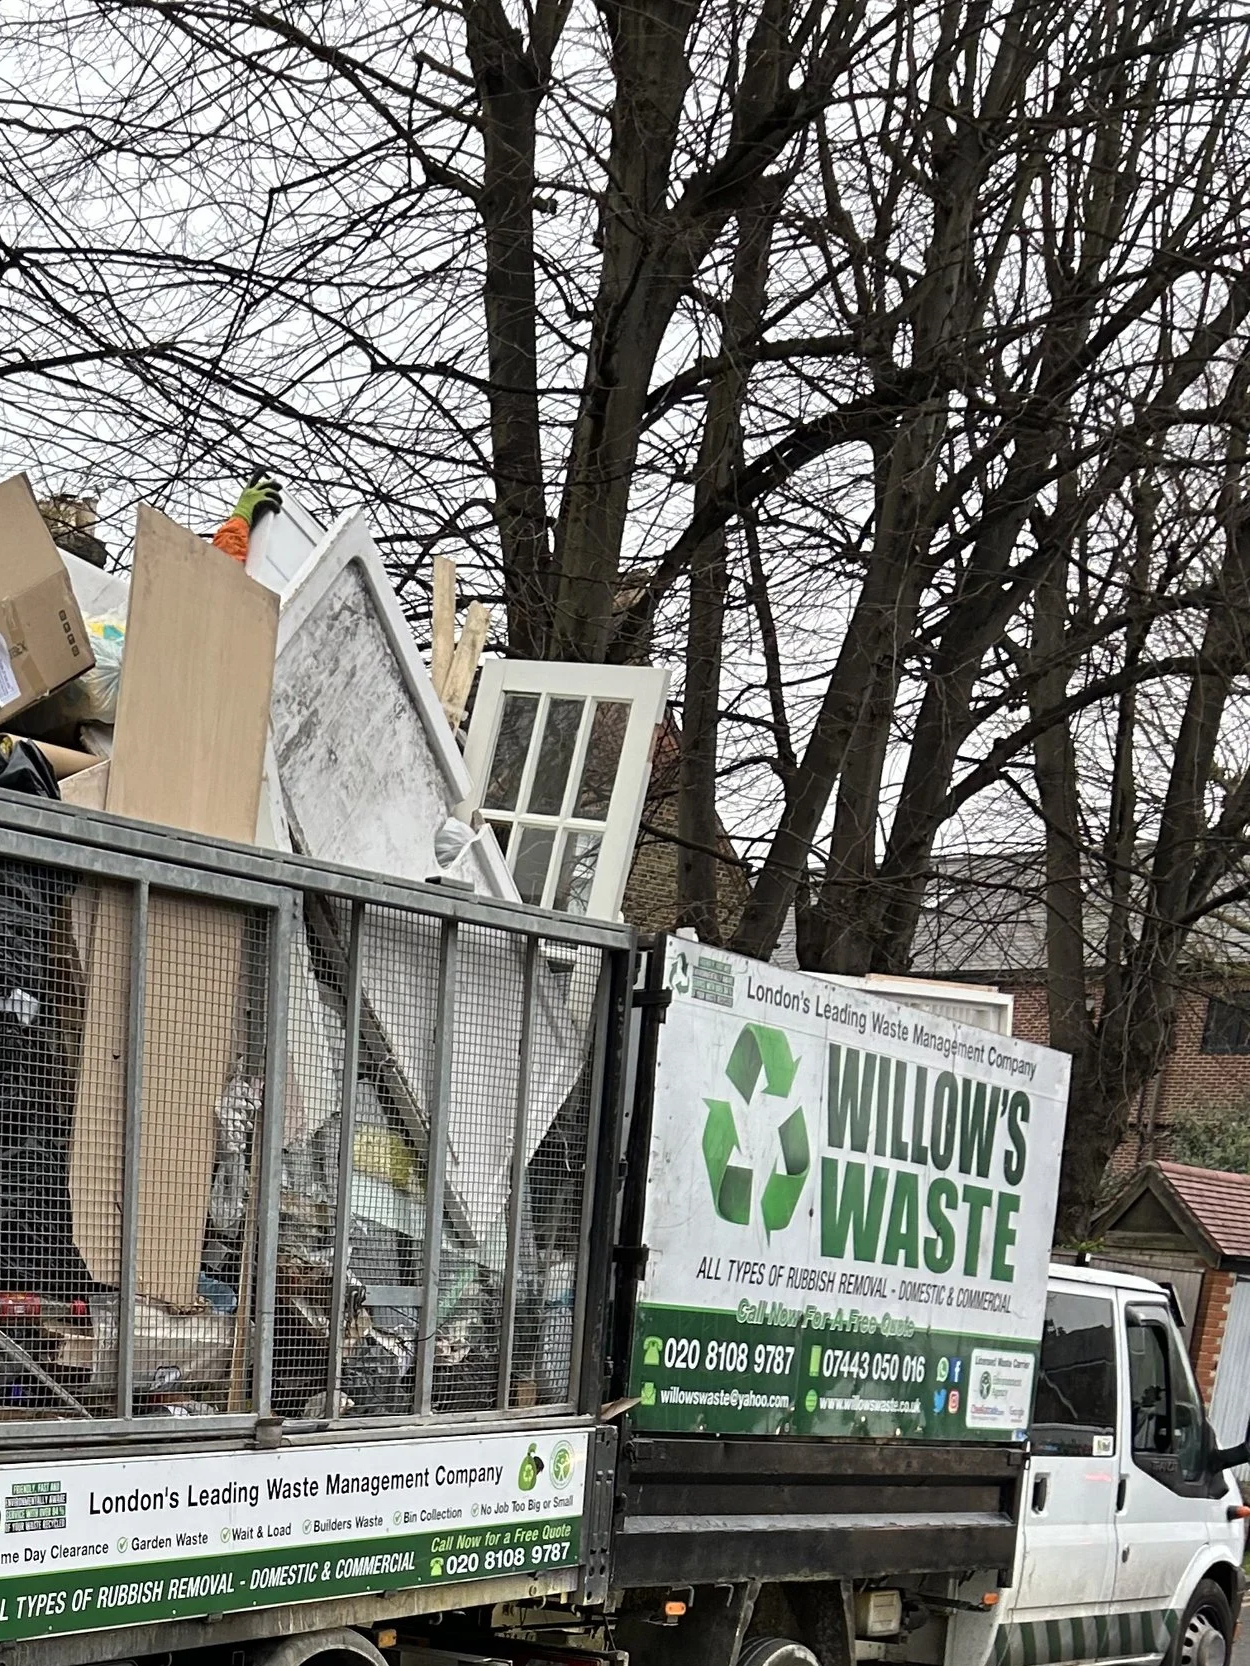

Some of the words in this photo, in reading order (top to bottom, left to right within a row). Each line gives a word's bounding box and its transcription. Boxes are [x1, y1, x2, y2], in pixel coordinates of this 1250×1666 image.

[747, 976, 810, 1014] London's
[815, 995, 867, 1034] Leading
[872, 1011, 908, 1041] Waste
[913, 1024, 984, 1063] Management
[988, 1046, 1037, 1082] Company
[828, 1043, 1030, 1186] WILLOW'S
[821, 1157, 1020, 1282] WASTE
[696, 1256, 721, 1280] ALL
[728, 1260, 764, 1286] TYPES
[769, 1264, 785, 1287] OF
[786, 1267, 835, 1293] RUBBISH
[838, 1273, 887, 1299] REMOVAL
[899, 1280, 945, 1306] DOMESTIC
[947, 1287, 954, 1307] &
[956, 1289, 1012, 1313] COMMERCIAL
[736, 1298, 764, 1323] Call
[767, 1302, 800, 1327] Now
[801, 1305, 827, 1330] For
[830, 1309, 845, 1331] A
[847, 1309, 878, 1334] Free
[880, 1311, 915, 1339] Quote
[664, 1338, 700, 1369] 020
[705, 1341, 748, 1372] 8108
[753, 1344, 795, 1375] 9787
[822, 1349, 870, 1379] 07443
[872, 1353, 900, 1381] 050
[902, 1355, 926, 1382] 016
[660, 1386, 789, 1410] willowswaste@yahoo.com
[819, 1395, 921, 1413] www.willowswaste.co.uk
[90, 1486, 179, 1515] London's
[187, 1481, 259, 1508] Leading
[267, 1477, 319, 1500] Waste
[326, 1468, 429, 1496] Management
[435, 1465, 503, 1488] Company
[481, 1503, 492, 1515] No
[494, 1502, 509, 1513] Job
[512, 1501, 525, 1512] Too
[528, 1499, 541, 1512] Big
[543, 1500, 551, 1509] or
[553, 1495, 573, 1508] Small
[314, 1518, 351, 1532] Builders
[355, 1515, 383, 1529] Waste
[403, 1511, 417, 1523] Bin
[420, 1507, 462, 1522] Collection
[131, 1536, 171, 1551] Garden
[176, 1533, 208, 1546] Waste
[232, 1528, 254, 1541] Wait
[257, 1526, 264, 1538] &
[267, 1523, 291, 1537] Load
[431, 1536, 453, 1553] Call
[456, 1534, 481, 1549] Now
[484, 1531, 500, 1547] for
[503, 1533, 510, 1544] a
[514, 1527, 538, 1543] Free
[542, 1524, 571, 1540] Quote
[24, 1548, 46, 1564] Day
[50, 1541, 109, 1559] Clearance
[446, 1553, 479, 1575] 020
[484, 1548, 525, 1569] 8108
[531, 1542, 570, 1564] 9787
[16, 1592, 67, 1619] TYPES
[72, 1588, 93, 1612] OF
[97, 1580, 163, 1609] RUBBISH
[168, 1572, 235, 1600] REMOVAL
[250, 1563, 318, 1590] DOMESTIC
[321, 1560, 331, 1581] &
[335, 1552, 415, 1578] COMMERCIAL
